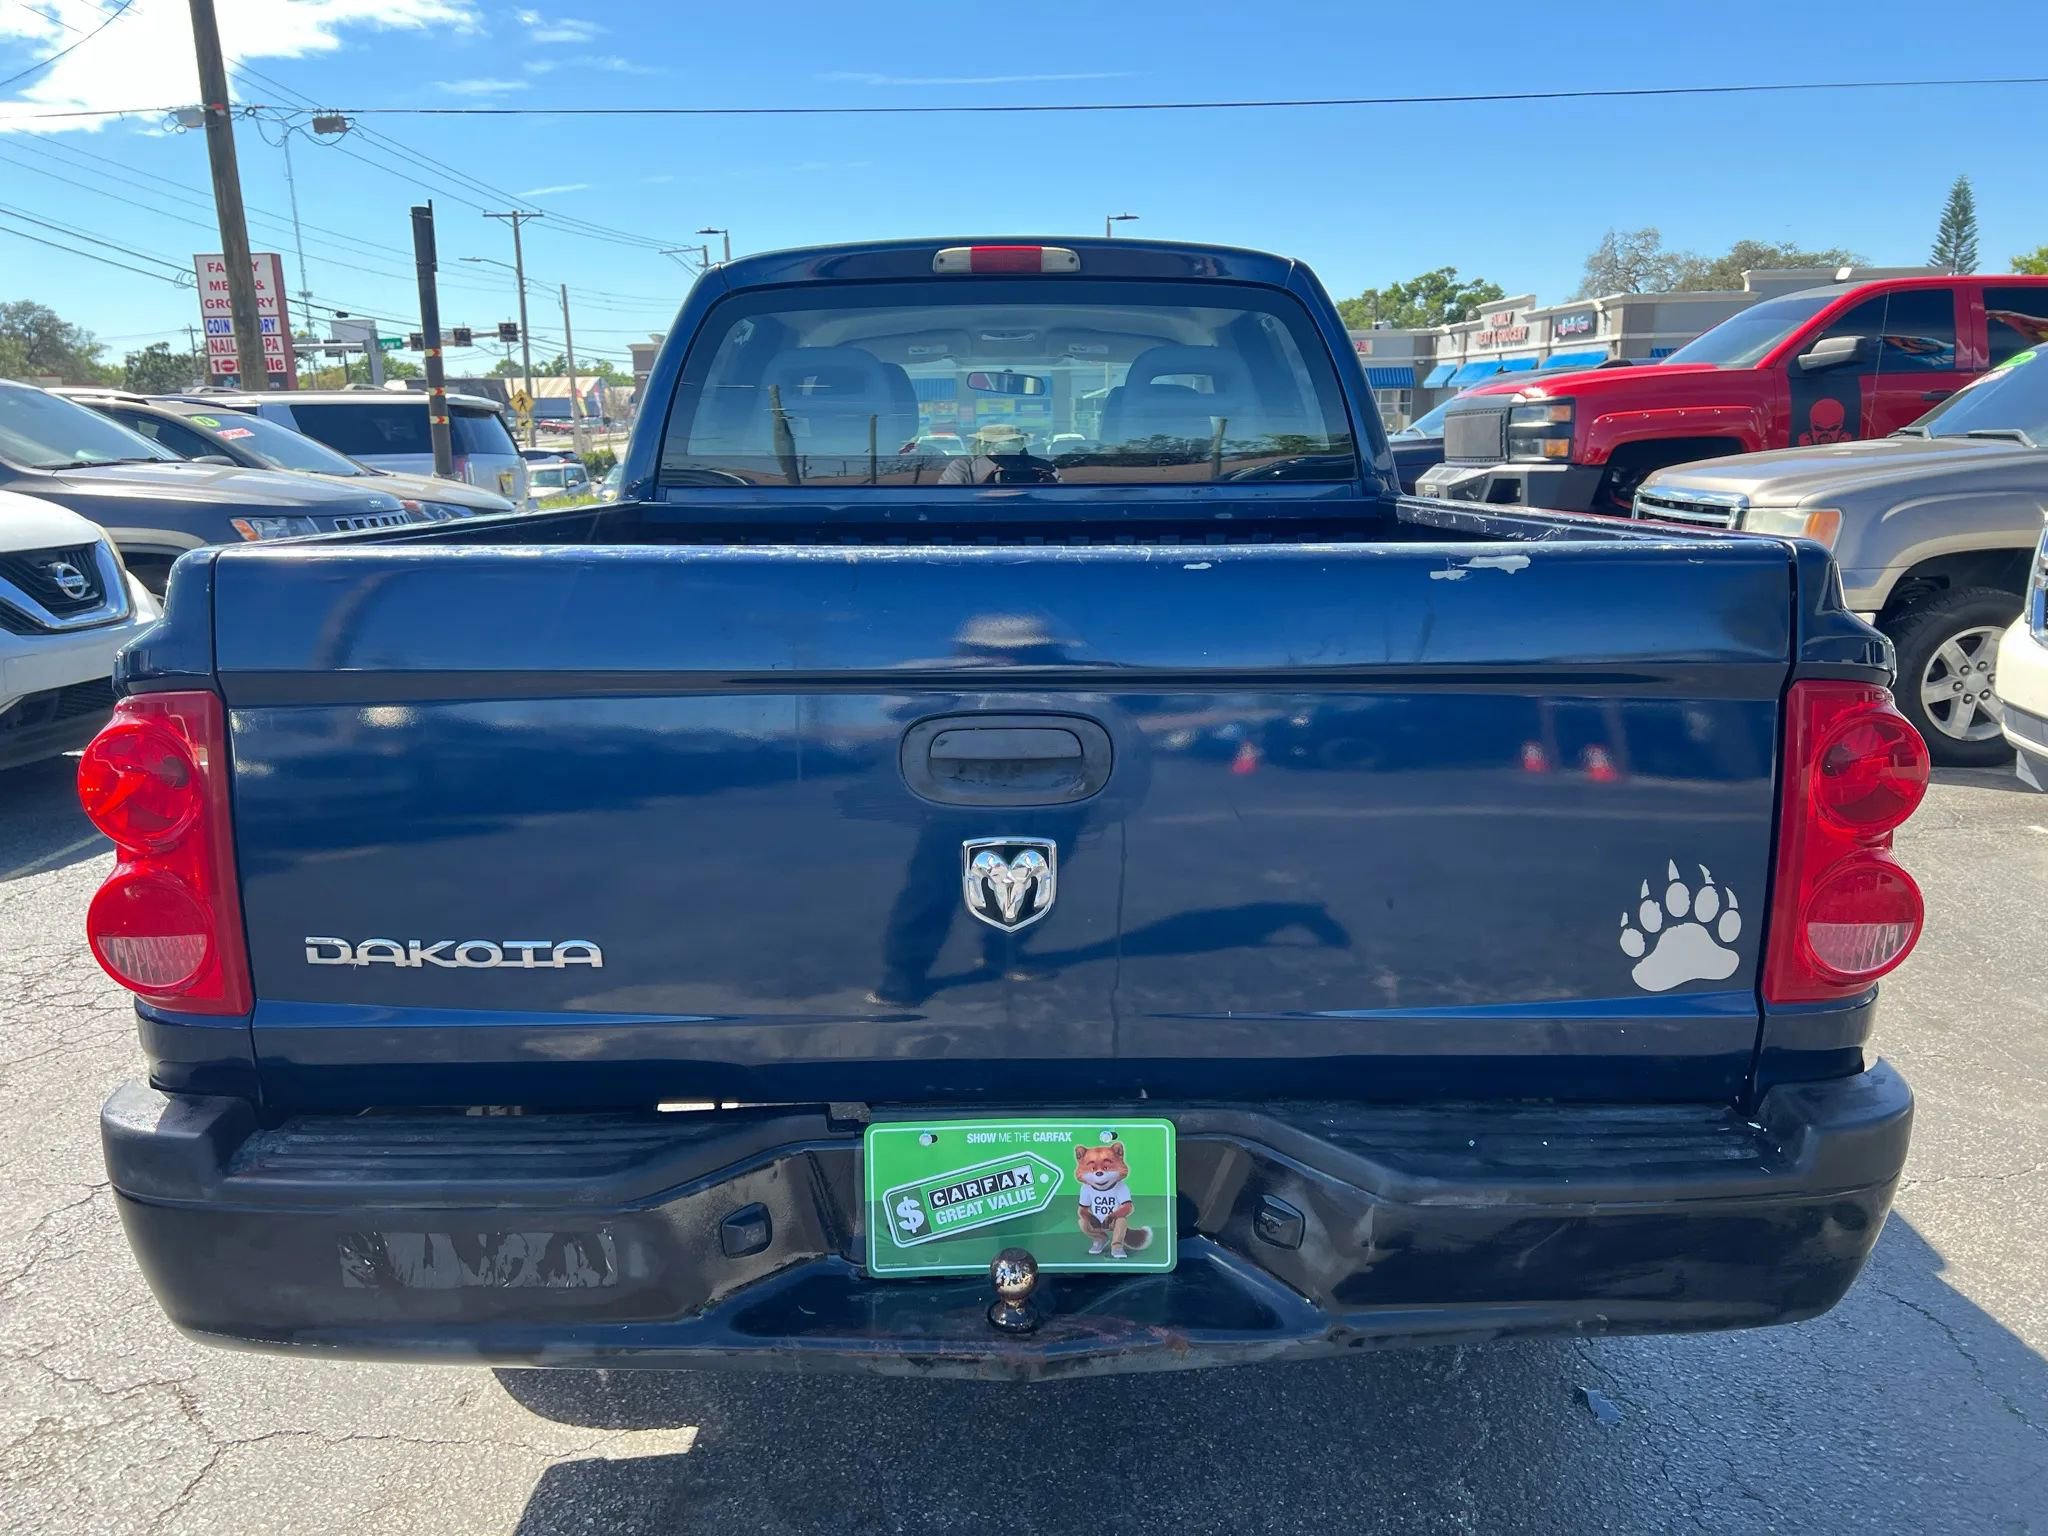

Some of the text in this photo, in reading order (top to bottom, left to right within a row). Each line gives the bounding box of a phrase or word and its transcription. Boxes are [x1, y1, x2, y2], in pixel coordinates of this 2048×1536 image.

[255, 280, 265, 290] &
[205, 297, 274, 308] GRORY
[207, 319, 231, 333] COIN
[264, 338, 279, 352] PA
[305, 936, 603, 968] DAKOTA
[967, 1132, 1073, 1144] SHOW ME THE CARFAX
[930, 1168, 1033, 1208] CARFAX
[936, 1187, 1037, 1225] GREAT VALUE
[1094, 1196, 1116, 1206] CAR
[896, 1196, 925, 1234] $
[1095, 1206, 1115, 1215] FOX
